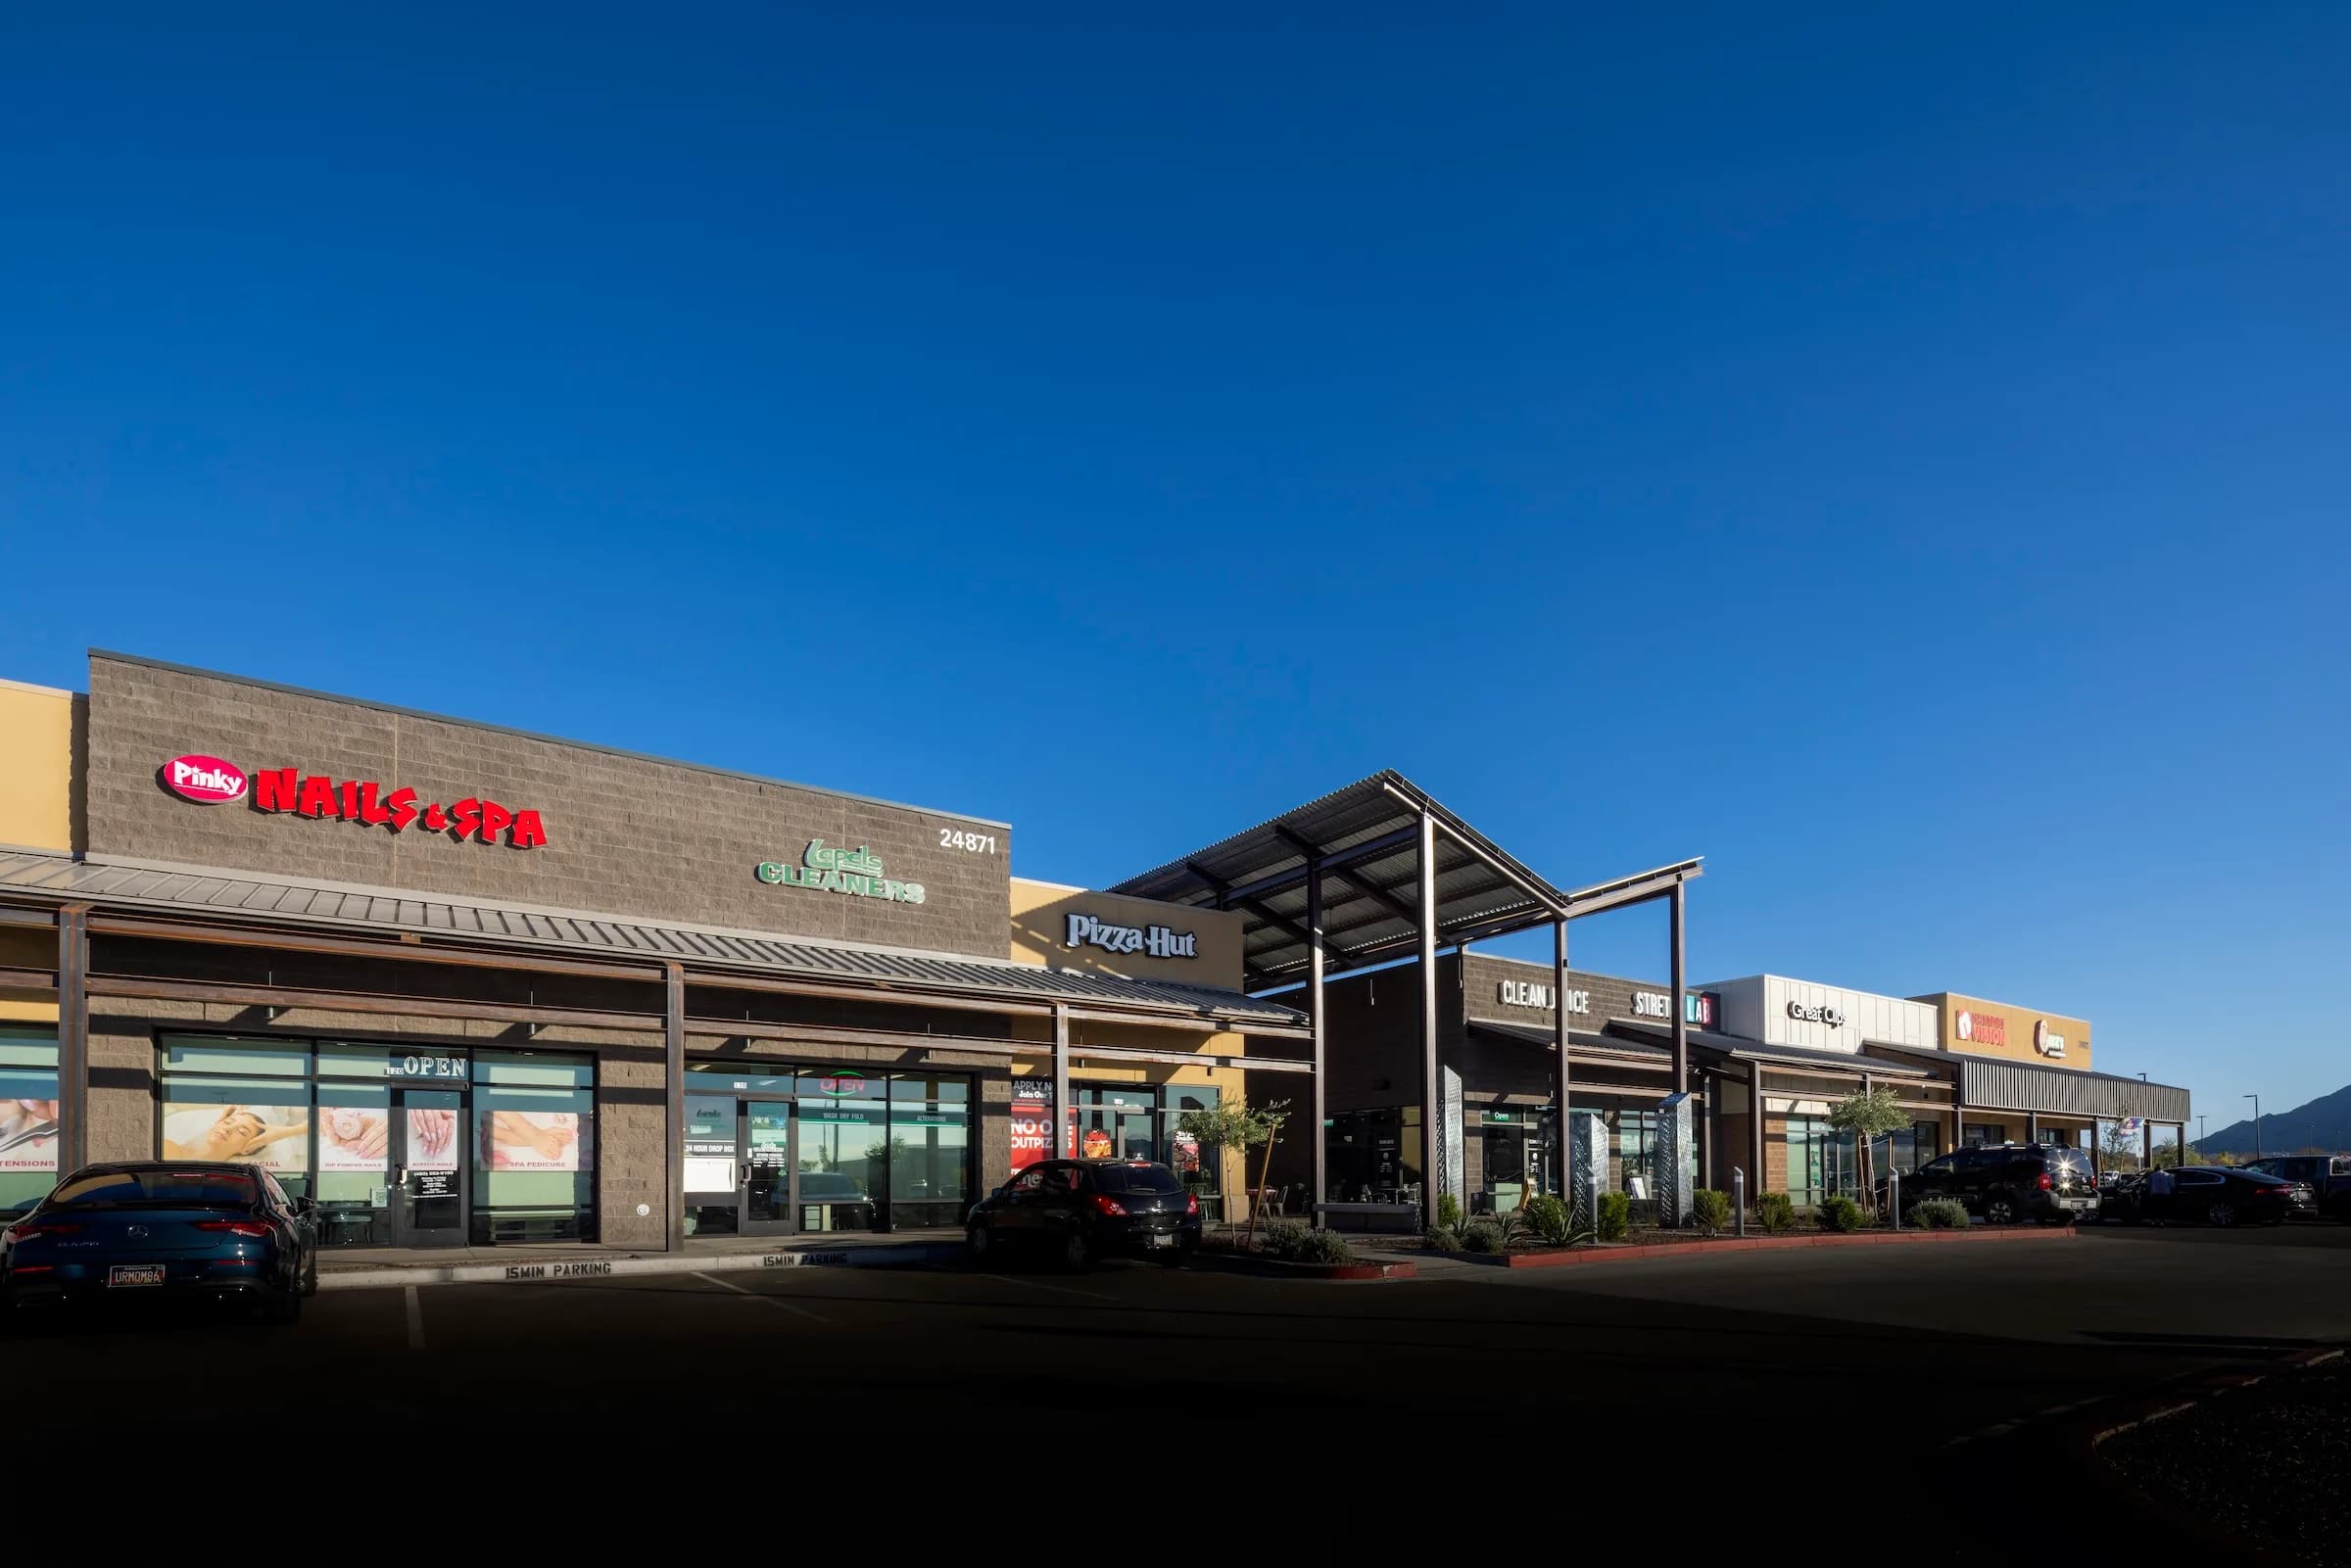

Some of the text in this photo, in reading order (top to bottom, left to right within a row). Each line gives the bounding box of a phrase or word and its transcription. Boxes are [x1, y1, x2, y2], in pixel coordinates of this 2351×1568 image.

[173, 760, 242, 795] Pinky
[257, 768, 549, 848] NAILS & SPA
[939, 829, 995, 854] 24871
[804, 838, 885, 875] Lapels
[758, 861, 926, 904] CLEANERS
[1065, 913, 1199, 959] Pizza Hut
[1502, 979, 1590, 1015] CLEAN JICE
[1636, 991, 1671, 1020] STRET
[1793, 1002, 1848, 1027] Great Clips
[404, 1056, 467, 1077] OPEN
[1013, 1080, 1043, 1091] APPLY
[1019, 1089, 1034, 1099] Join
[1011, 1118, 1036, 1135] NO
[552, 1261, 611, 1276] PARKING
[800, 1252, 847, 1265] PARKING
